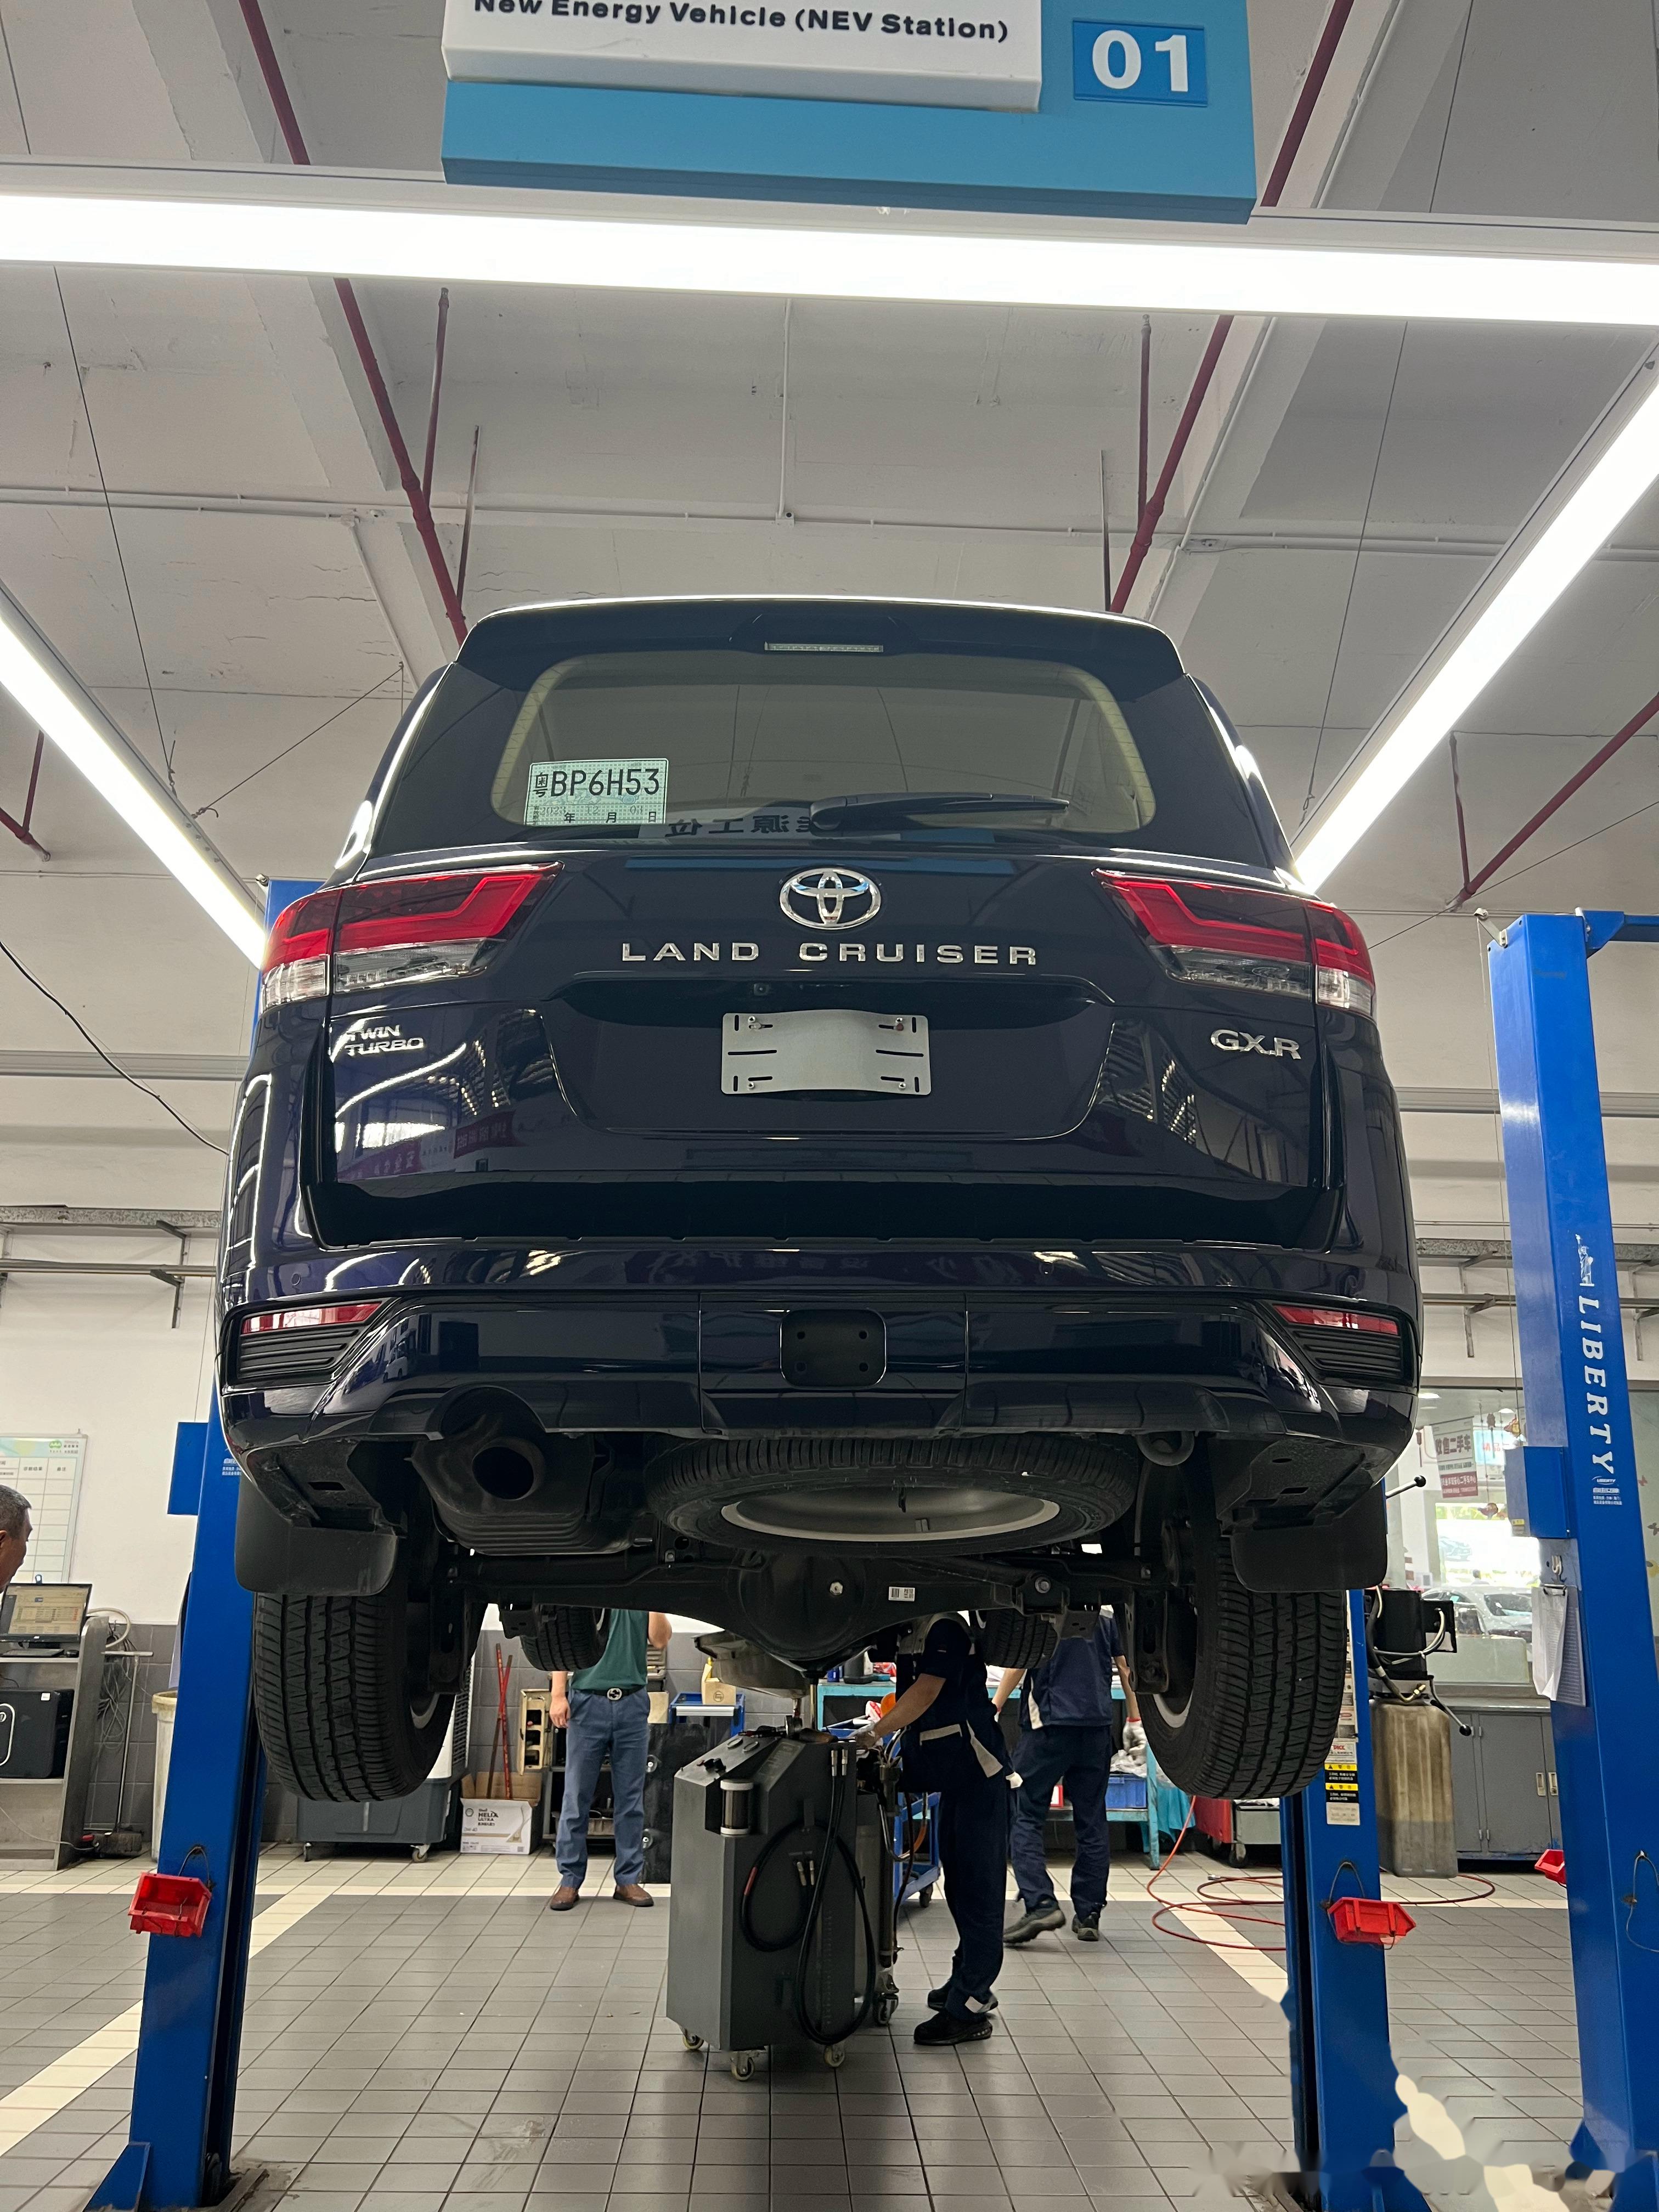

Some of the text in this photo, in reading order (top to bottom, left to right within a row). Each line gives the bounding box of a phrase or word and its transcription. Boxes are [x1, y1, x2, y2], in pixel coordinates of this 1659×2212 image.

[474, 0, 1008, 43] New Energy Vehicle (NEV Station)
[1092, 30, 1188, 92] 01
[533, 768, 659, 798] 粤BP6H53
[564, 812, 575, 823] 年
[606, 812, 617, 823] 月
[648, 811, 656, 823] 日
[622, 942, 1037, 966] LAND CRUISER
[344, 1036, 424, 1057] TURBO
[346, 1024, 400, 1042] TWIN
[1210, 1029, 1301, 1060] GXR
[1578, 1295, 1614, 1474] LIBERTY
